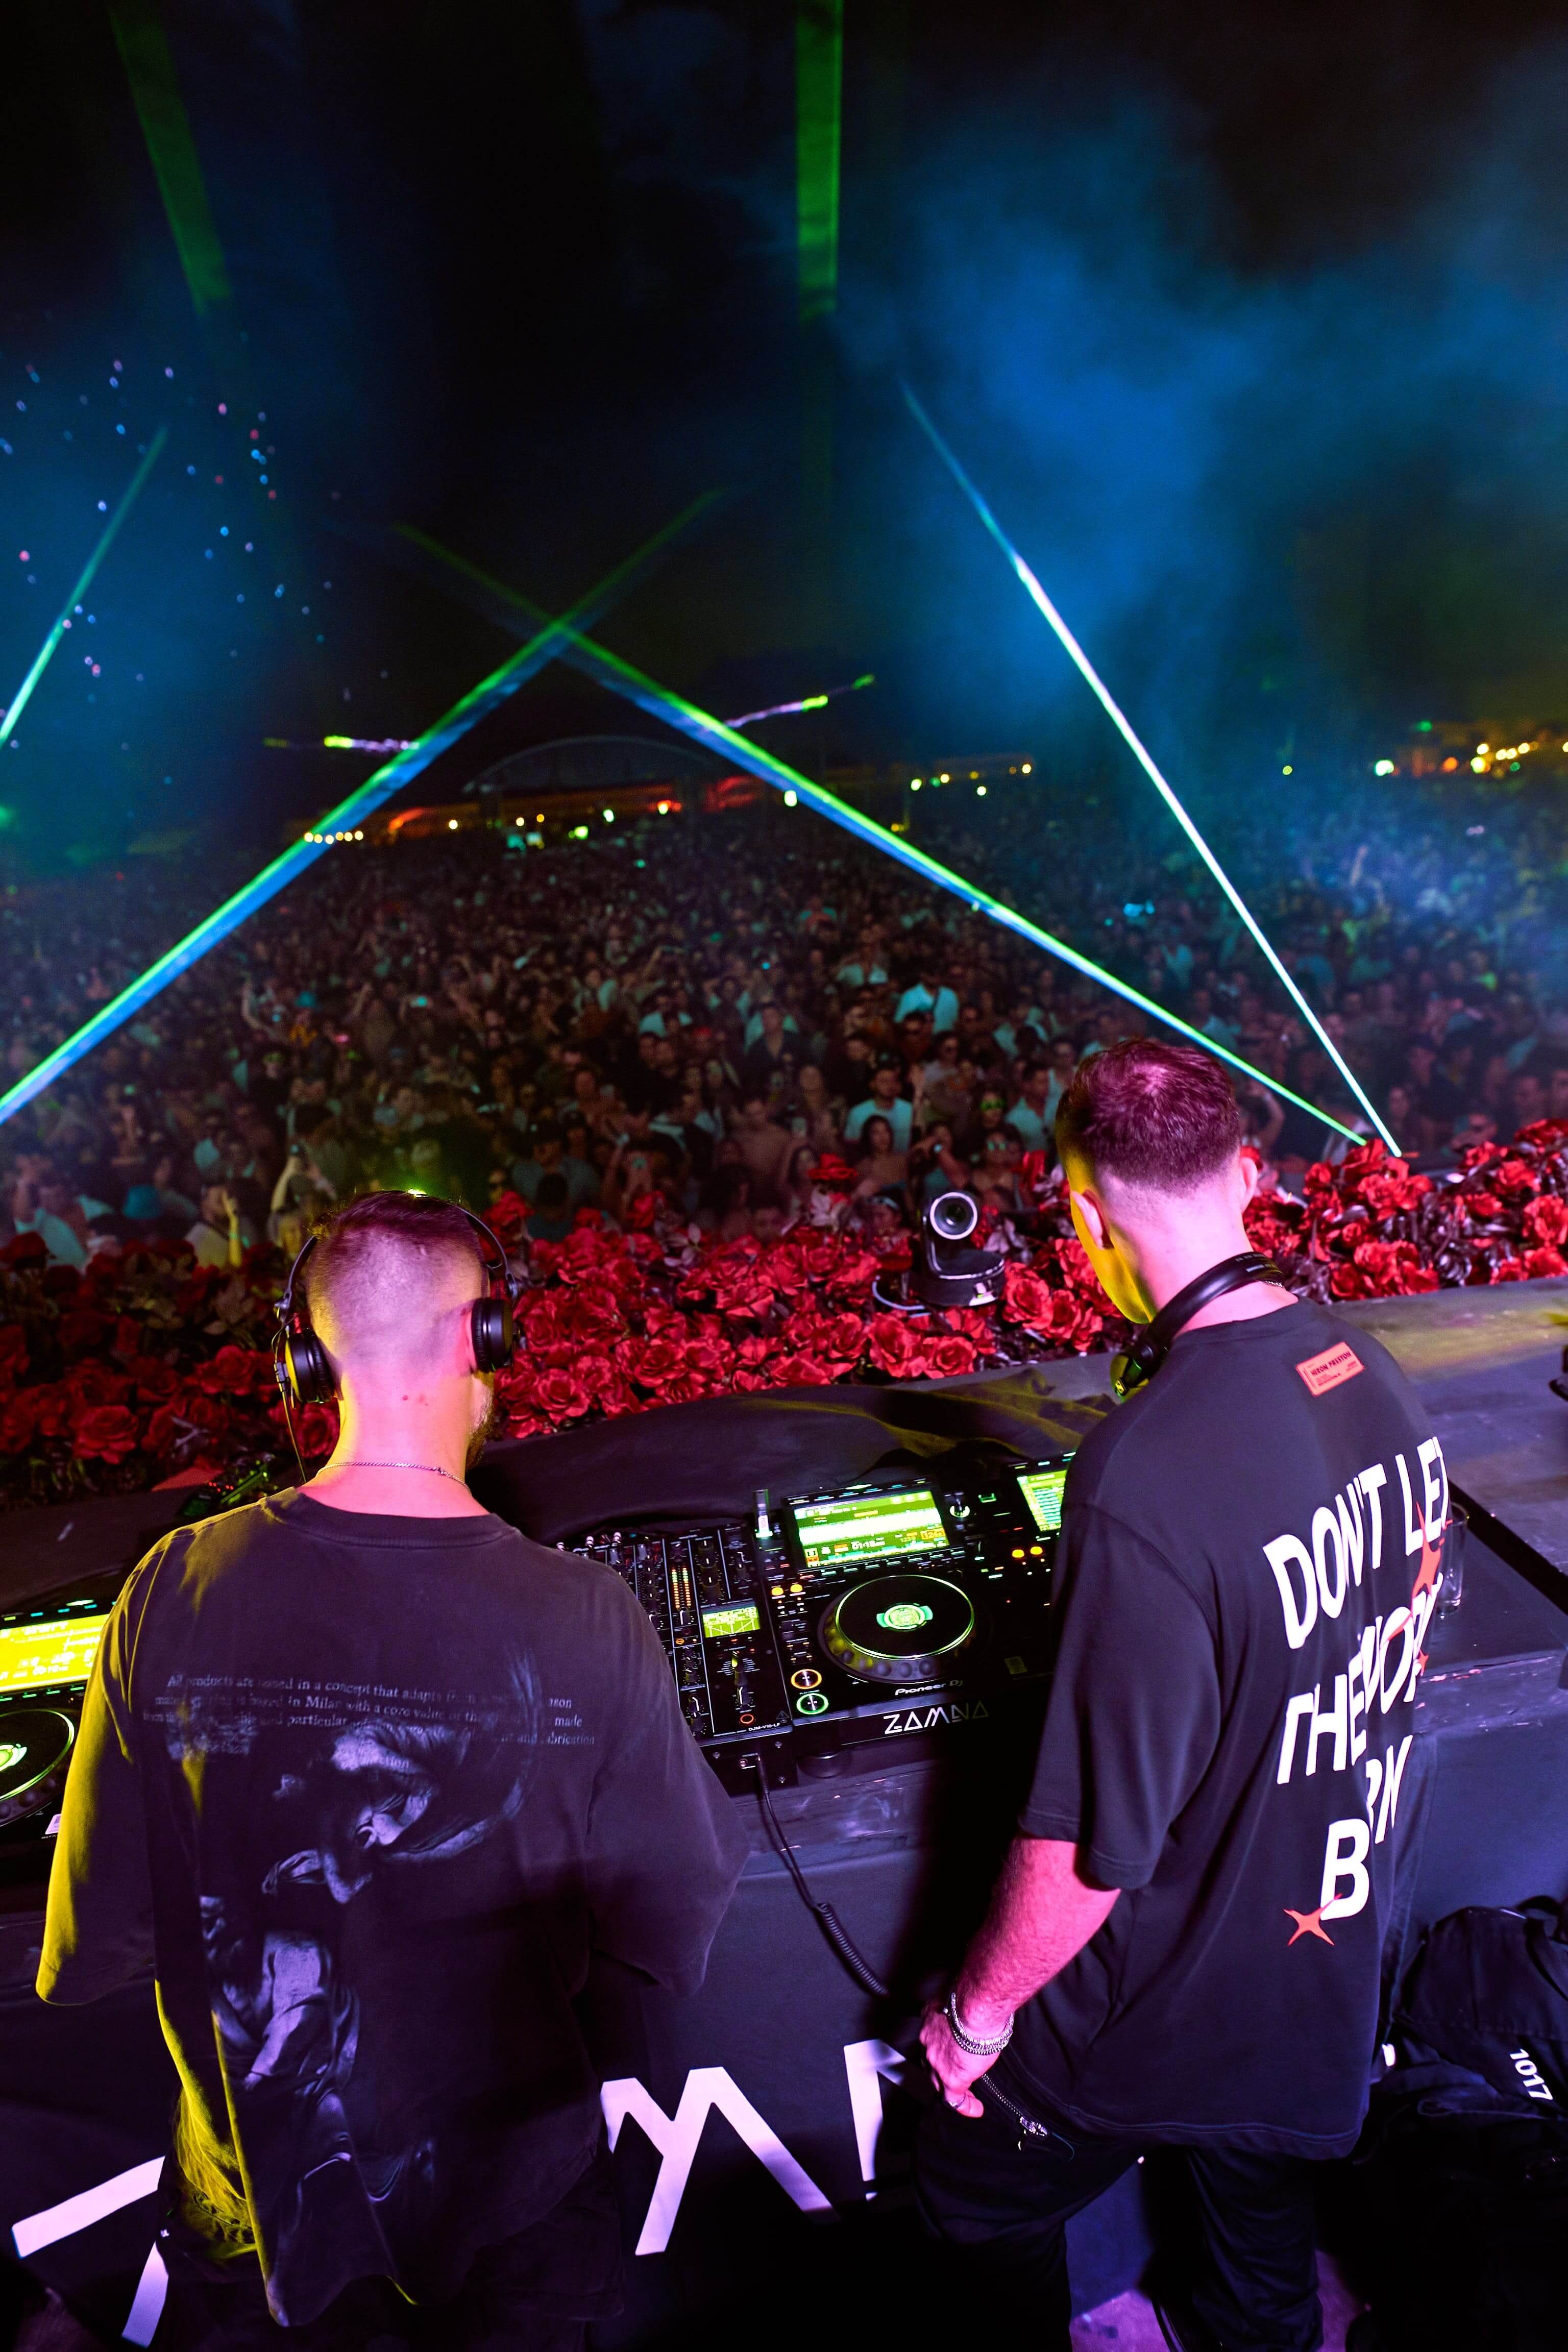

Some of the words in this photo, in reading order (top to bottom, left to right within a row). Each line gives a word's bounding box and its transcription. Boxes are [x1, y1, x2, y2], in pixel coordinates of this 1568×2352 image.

[1328, 1351, 1352, 1368] PRESTON
[1262, 1463, 1387, 1649] DON'T
[298, 1679, 310, 1690] in
[314, 1682, 321, 1690] a
[325, 1682, 371, 1697] concept
[373, 1684, 399, 1698] that
[895, 1683, 946, 1696] Pioneer
[286, 1714, 348, 1727] particular
[306, 1695, 342, 1709] Milan
[346, 1700, 370, 1712] with
[374, 1705, 380, 1713] a
[383, 1707, 410, 1717] core
[554, 1714, 582, 1727] made
[883, 1700, 990, 1734] ZAMNA
[1277, 1651, 1367, 1785] THE
[748, 1723, 780, 1731] DJM-V10-LF
[1509, 2048, 1553, 2100] 1017
